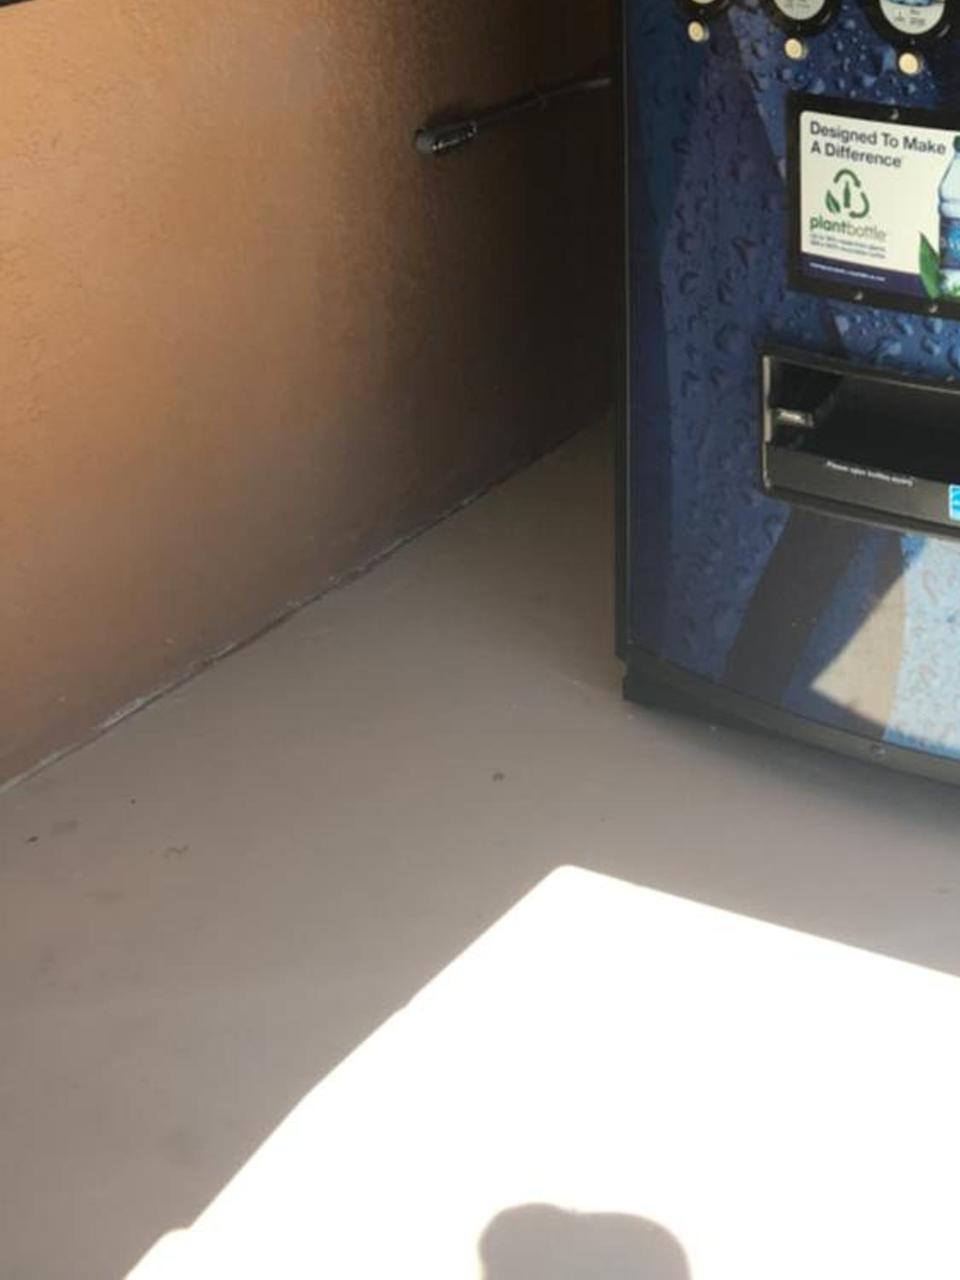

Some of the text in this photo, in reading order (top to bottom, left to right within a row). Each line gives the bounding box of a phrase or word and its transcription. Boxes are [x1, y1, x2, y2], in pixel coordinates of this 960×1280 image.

[809, 121, 946, 155] Designed To Make
[811, 141, 902, 168] A Difference
[809, 215, 886, 241] plantbottle
